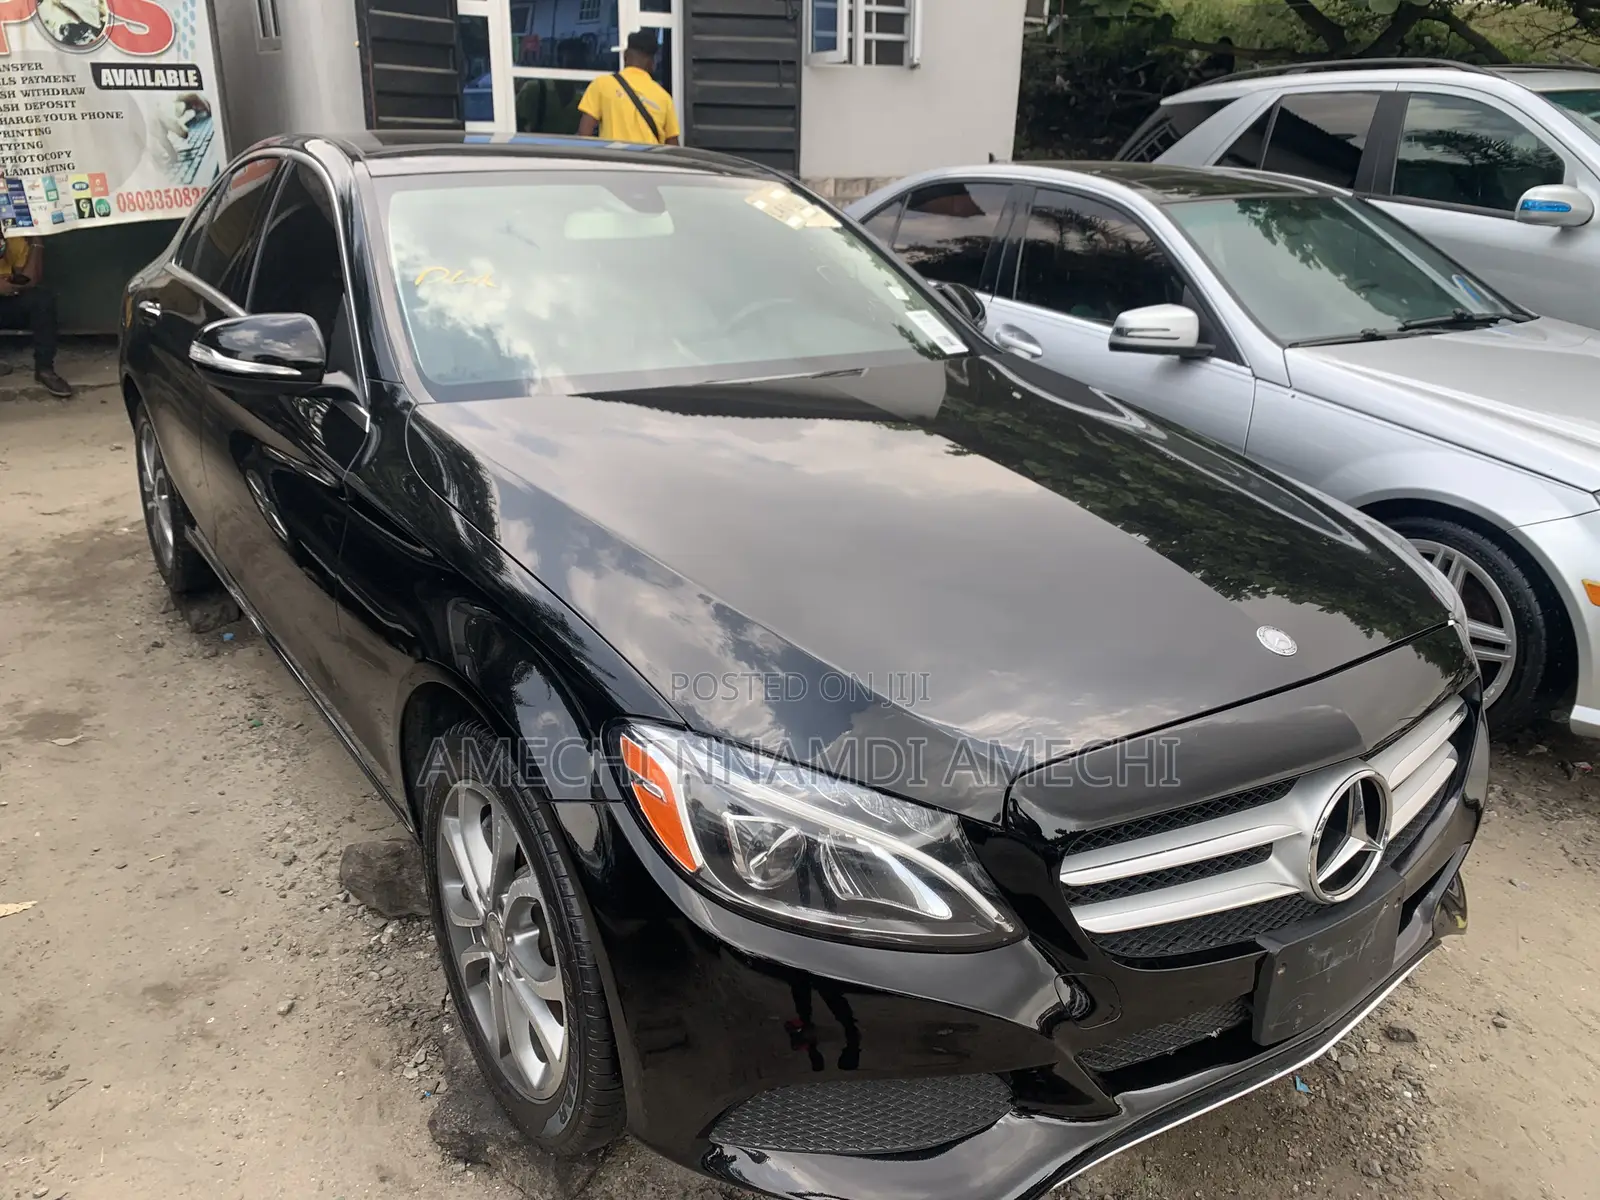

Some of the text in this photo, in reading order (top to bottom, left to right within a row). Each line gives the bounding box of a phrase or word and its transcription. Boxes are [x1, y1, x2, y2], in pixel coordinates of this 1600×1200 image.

[0, 63, 43, 72] NSFER
[0, 75, 76, 86] LS PAYMENT
[101, 68, 200, 87] AVAILABLE
[20, 87, 86, 98] WITHDRAW
[24, 101, 76, 111] DEPOSIT
[43, 112, 77, 122] YOUR
[81, 111, 124, 120] PHONE
[0, 126, 51, 138] RINTING
[1, 150, 72, 164] PHOTOCOPY
[4, 162, 76, 176] LAMINATING
